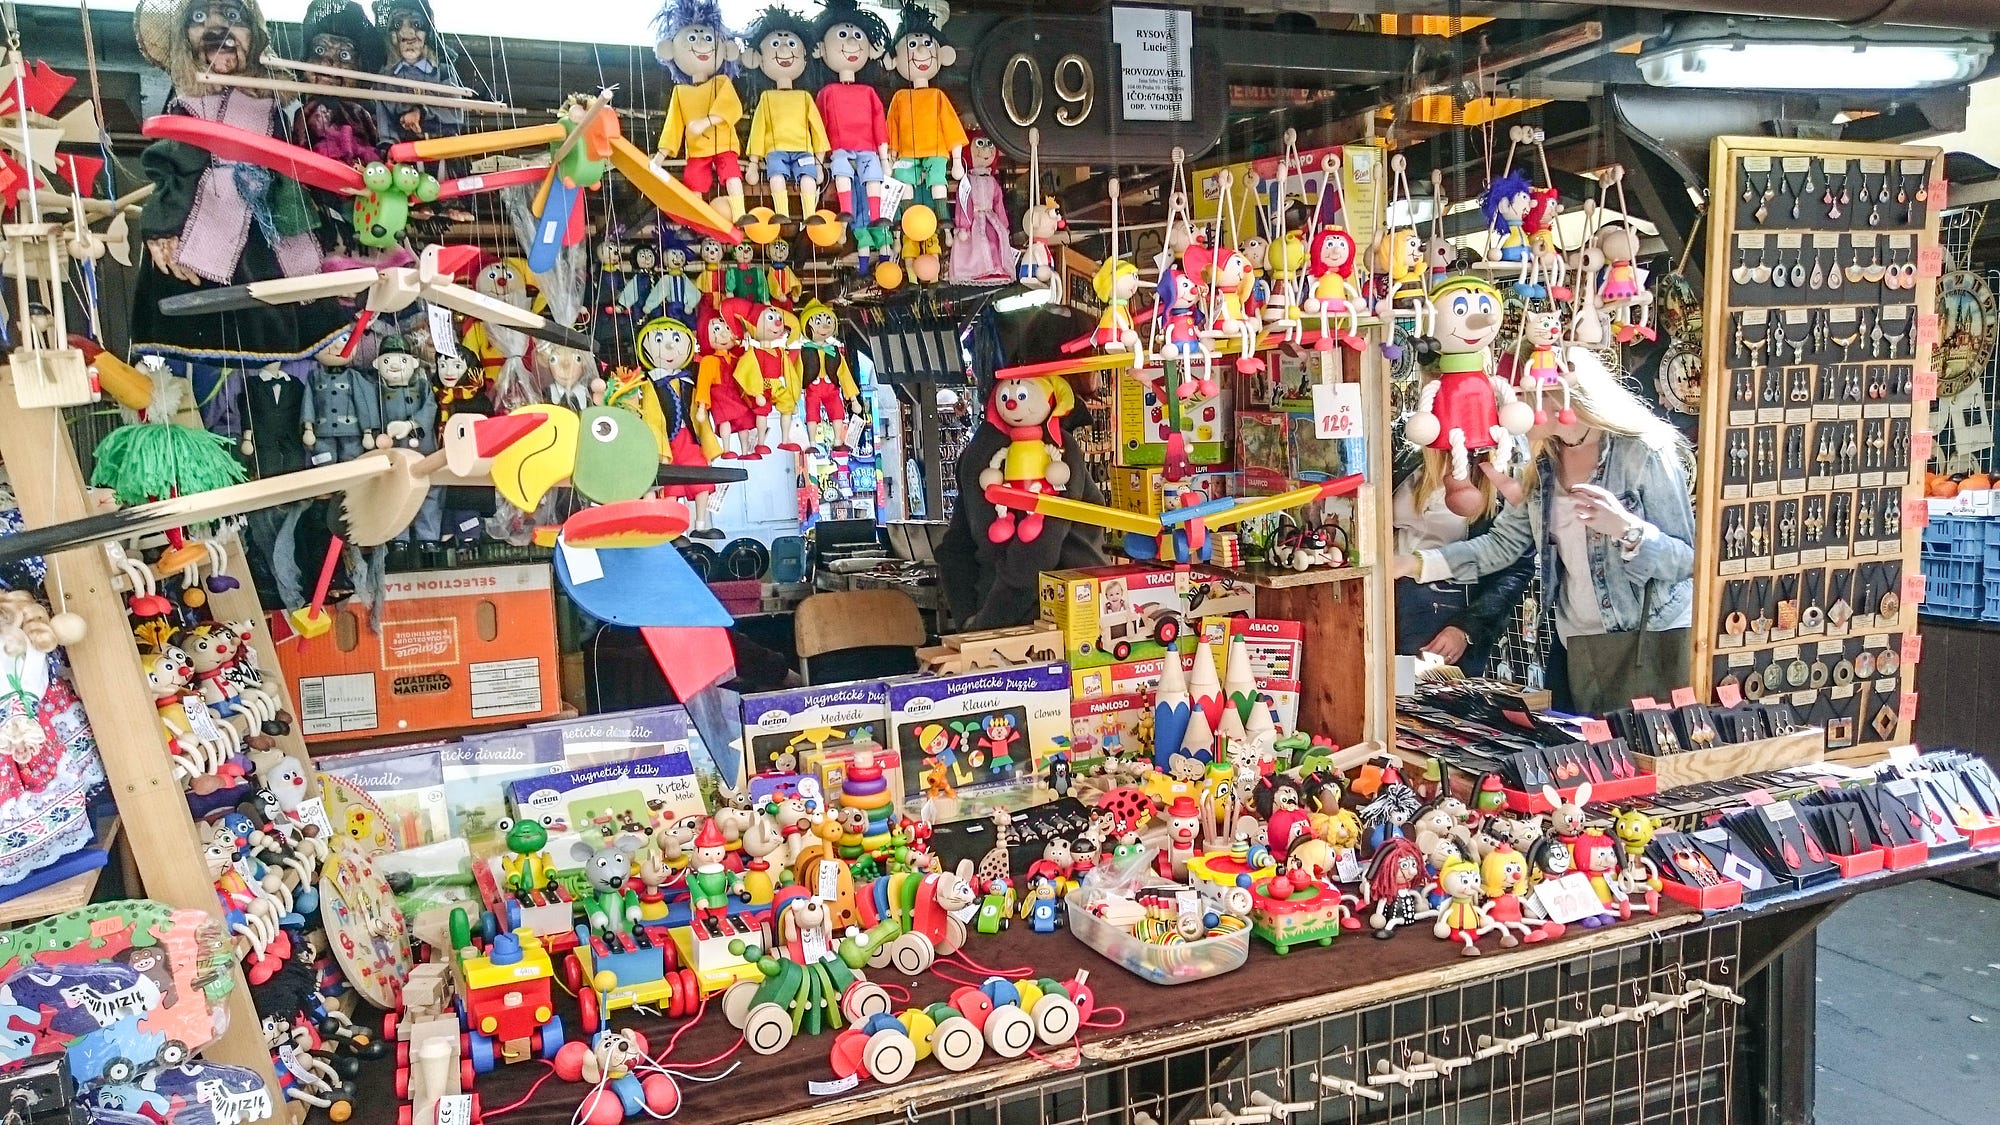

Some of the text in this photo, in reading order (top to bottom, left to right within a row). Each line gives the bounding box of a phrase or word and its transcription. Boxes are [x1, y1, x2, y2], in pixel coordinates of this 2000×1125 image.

[1001, 53, 1094, 127] 09
[1249, 623, 1279, 632] ABACO
[1134, 663, 1154, 674] ZOO
[947, 677, 1038, 695] Magnetické puzzle
[804, 689, 865, 708] Magnetické
[1034, 708, 1062, 719] Clowns
[475, 747, 526, 761] divadlo
[350, 772, 403, 786] divadlo
[570, 765, 630, 785] Magnetické
[656, 779, 691, 795] Krtek
[675, 791, 695, 802] Mole
[49, 938, 57, 948] 8
